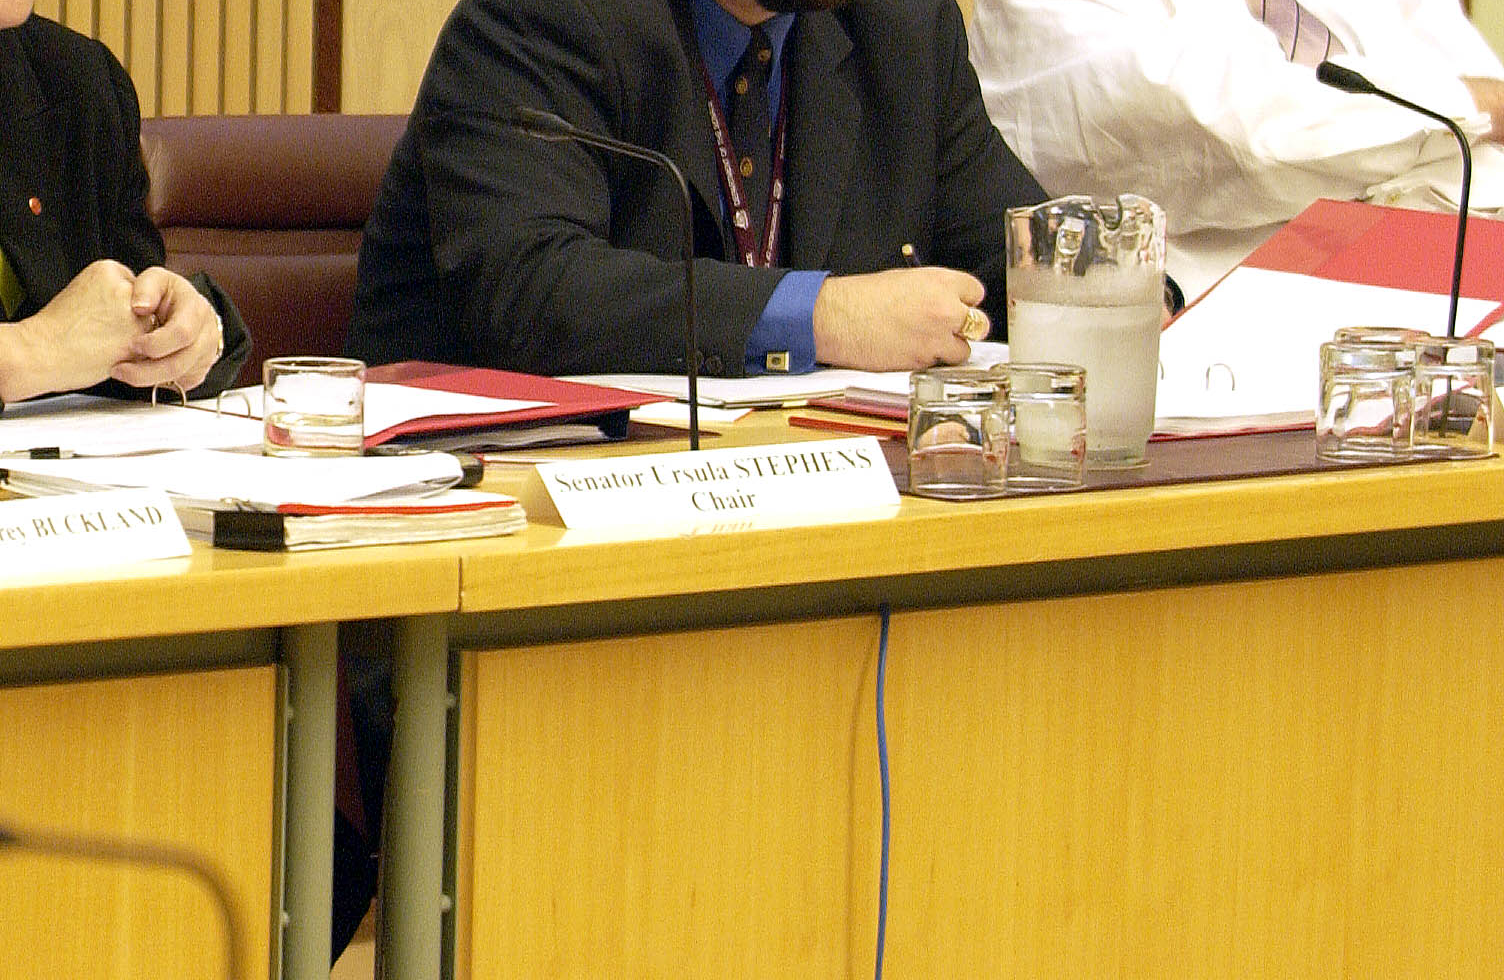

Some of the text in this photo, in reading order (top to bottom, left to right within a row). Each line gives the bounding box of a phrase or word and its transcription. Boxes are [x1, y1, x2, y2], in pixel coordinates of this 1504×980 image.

[554, 448, 872, 493] Senator Ursula STEPHENS
[691, 488, 756, 512] Chair
[33, 506, 163, 537] BUCKLAND
